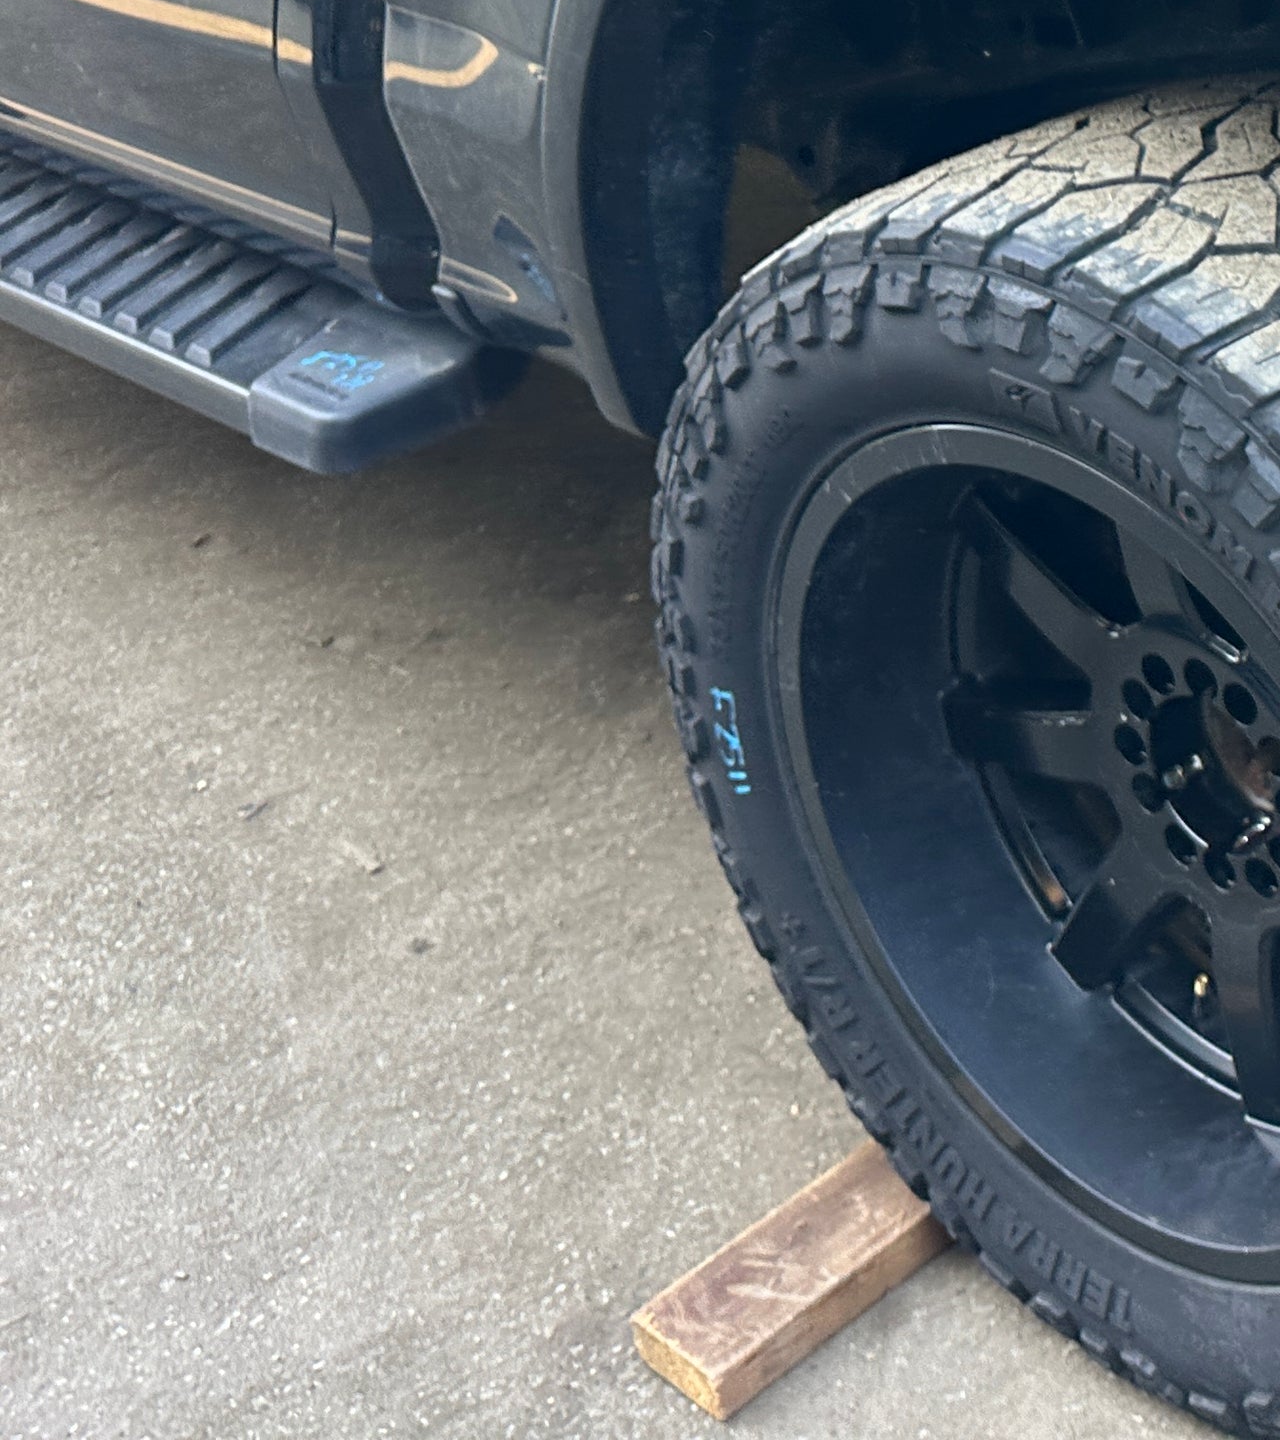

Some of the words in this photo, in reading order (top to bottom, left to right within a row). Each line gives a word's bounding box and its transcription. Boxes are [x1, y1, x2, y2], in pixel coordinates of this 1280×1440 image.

[1067, 405, 1258, 581] VENOM
[850, 1036, 999, 1224] HUNTER
[1001, 1202, 1135, 1330] TERRA
